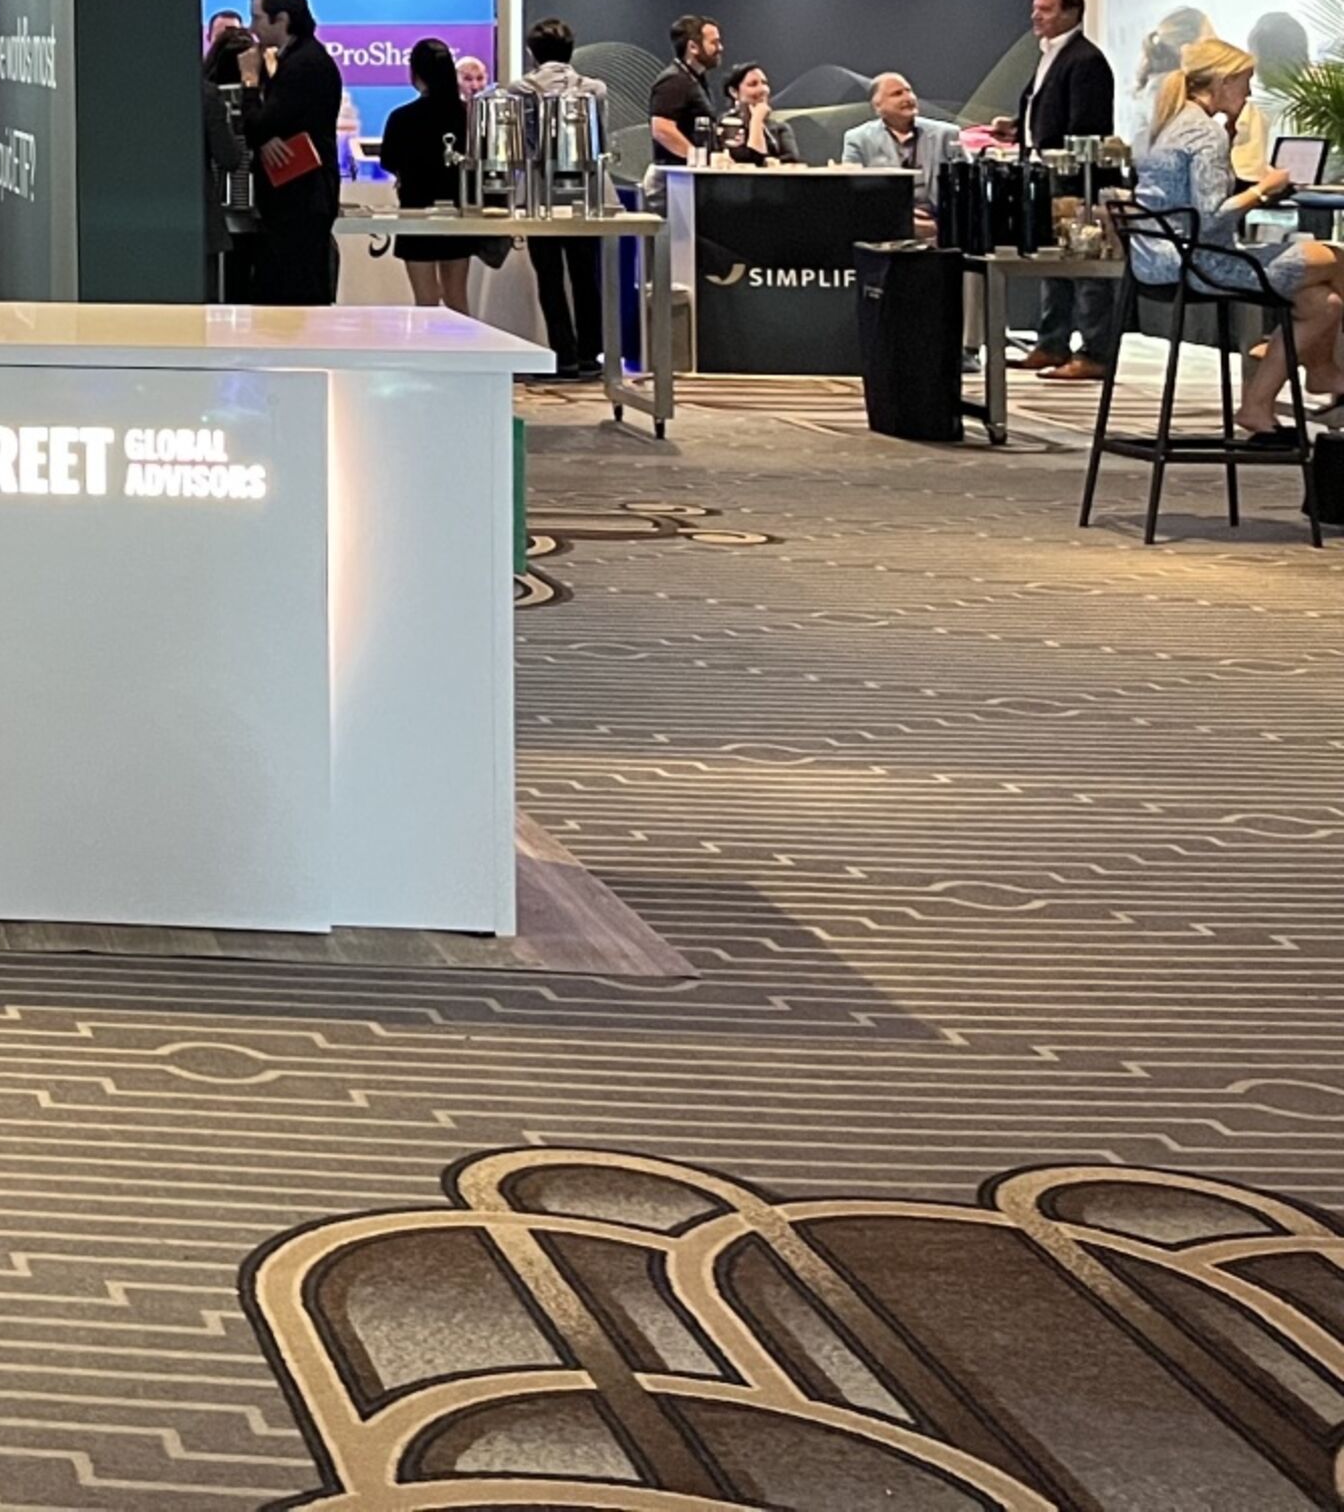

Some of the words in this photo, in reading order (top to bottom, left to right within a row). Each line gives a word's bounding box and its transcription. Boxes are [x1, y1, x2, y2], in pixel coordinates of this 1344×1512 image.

[325, 41, 413, 66] ProSha
[749, 268, 857, 287] SIMPLIF
[124, 428, 227, 461] GLOBAL
[124, 463, 267, 499] ADVISORS
